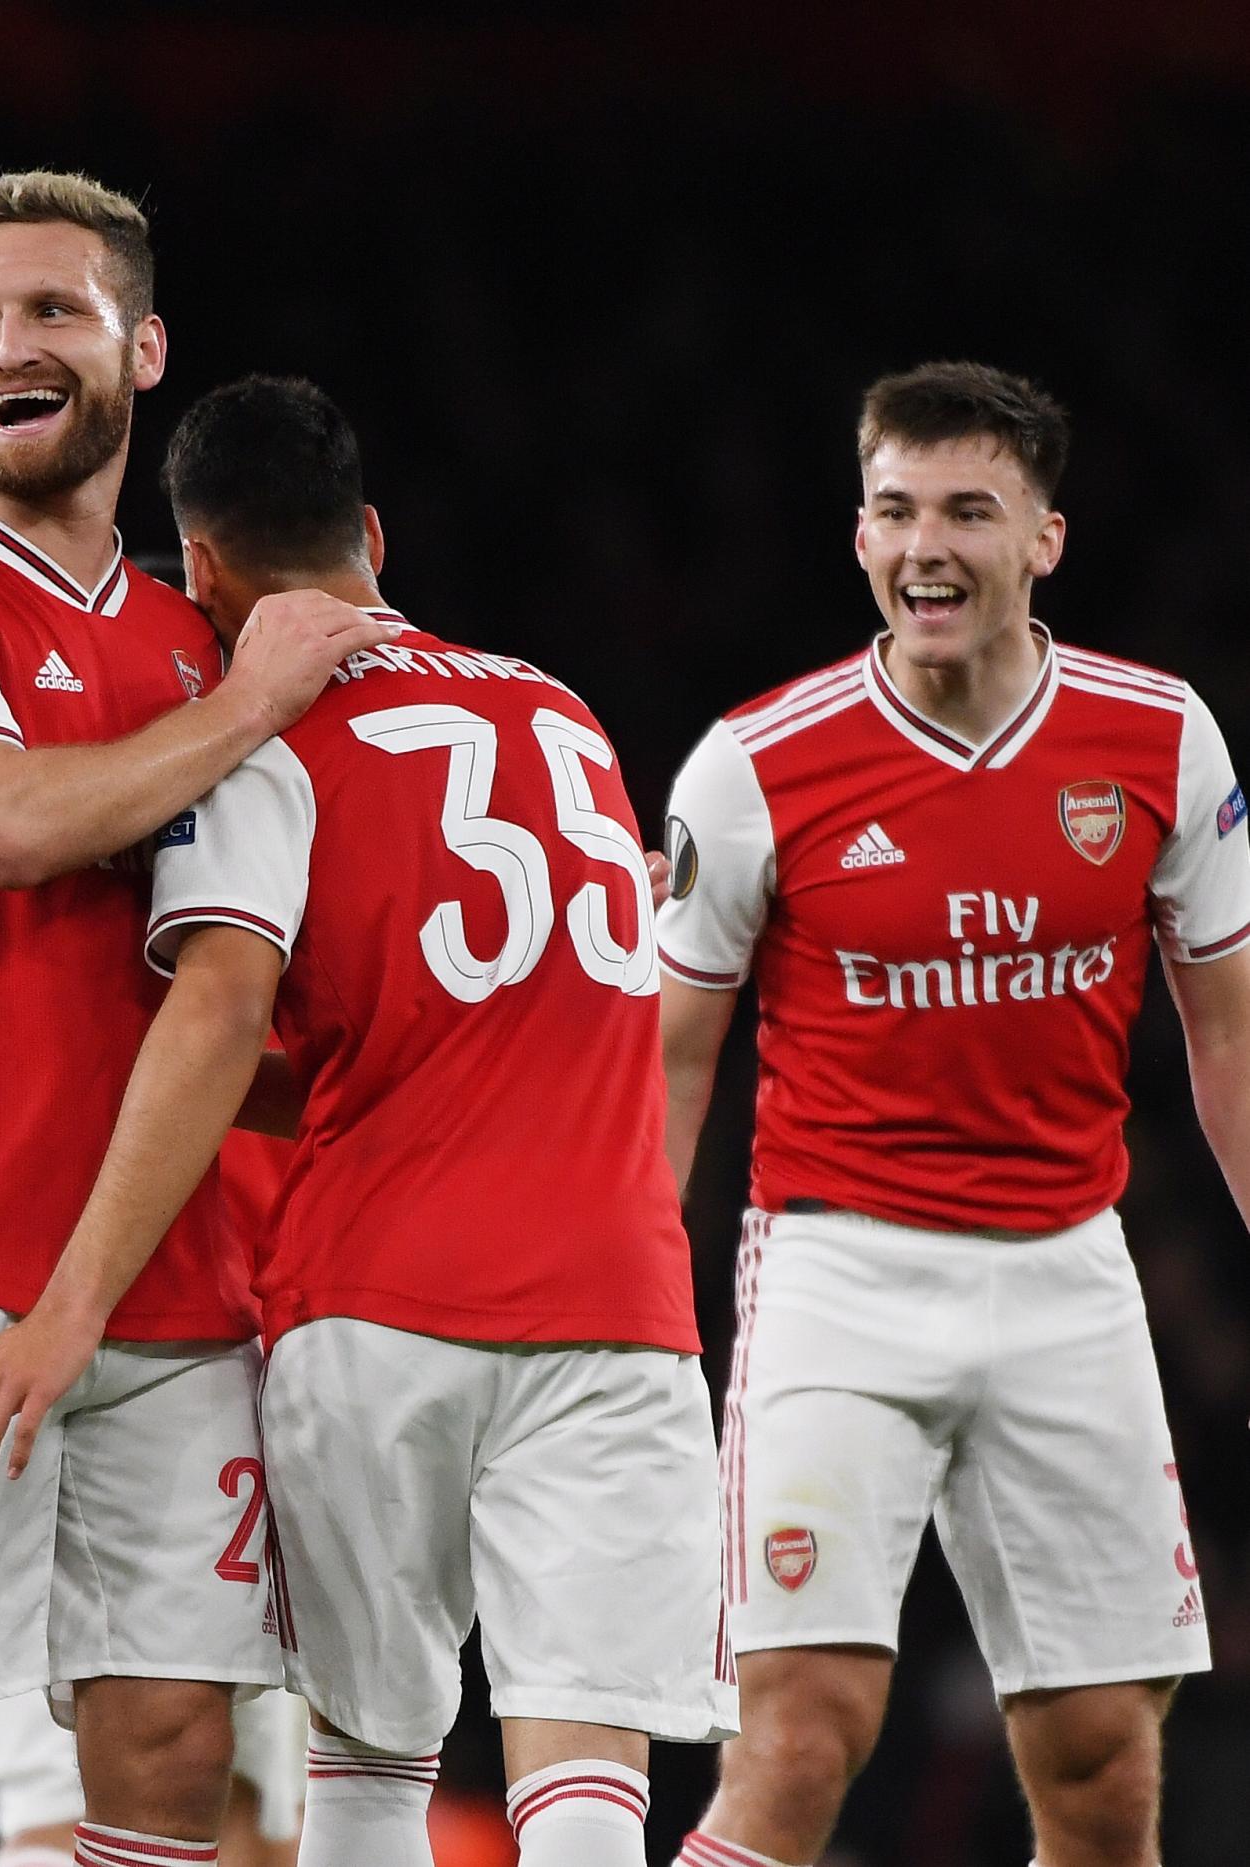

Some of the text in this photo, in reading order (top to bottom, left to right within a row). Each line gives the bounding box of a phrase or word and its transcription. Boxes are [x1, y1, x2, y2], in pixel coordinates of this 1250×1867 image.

[34, 674, 84, 693] adidas
[1067, 793, 1116, 811] Arsenal
[347, 703, 662, 1004] 35
[840, 849, 906, 869] adidas
[947, 890, 1039, 943] Fly
[836, 936, 1117, 1008] Emirates
